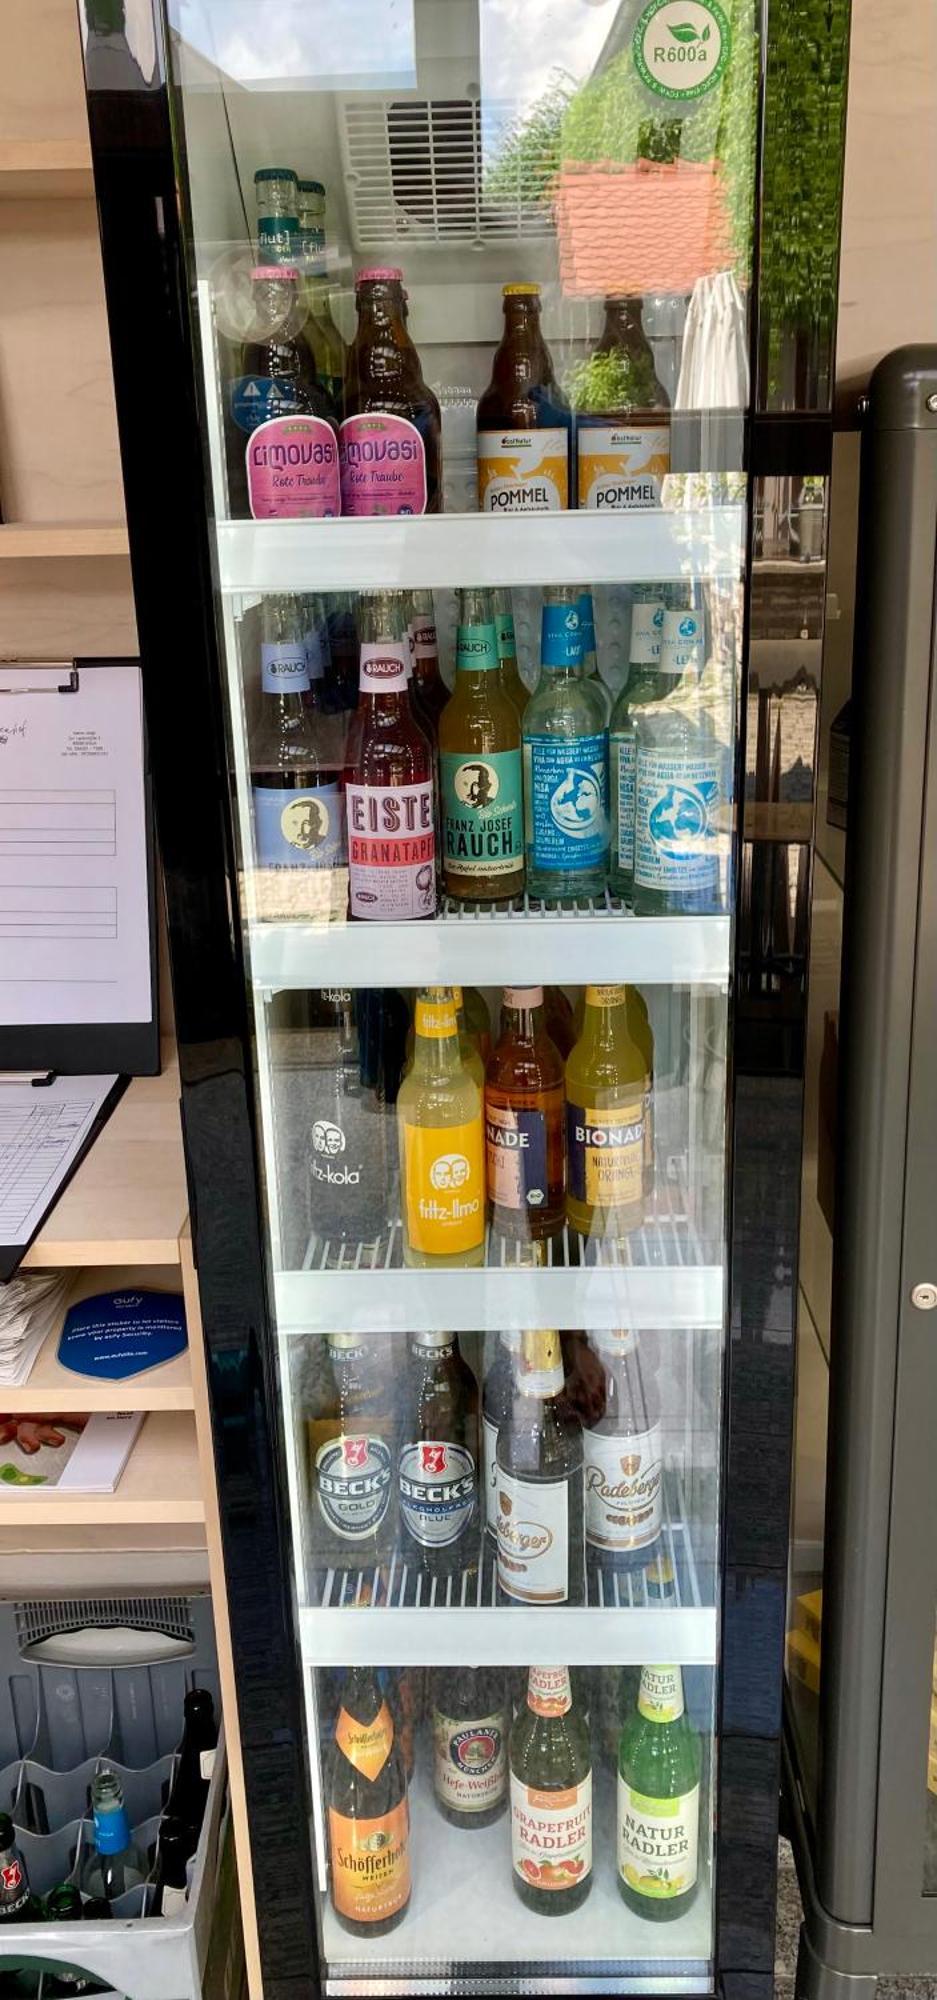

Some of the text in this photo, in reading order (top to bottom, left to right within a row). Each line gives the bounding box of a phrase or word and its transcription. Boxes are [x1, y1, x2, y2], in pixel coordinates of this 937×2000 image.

[654, 47, 707, 62] R600a
[491, 487, 549, 512] POMMEL
[597, 485, 655, 508] POMMEL
[373, 663, 401, 672] RAUCH
[352, 794, 430, 832] EISTE
[446, 817, 513, 833] FRANZ JOSEF
[447, 831, 513, 857] RAUCH
[418, 1197, 480, 1221] fritz-limo
[319, 1467, 391, 1496] BECK'S
[400, 1473, 475, 1502] BECK'S
[338, 1500, 376, 1513] GOLD
[419, 1513, 451, 1523] BLUE
[520, 1826, 586, 1849] RADLER
[626, 1814, 685, 1841] NATUR
[622, 1826, 689, 1857] RADLER
